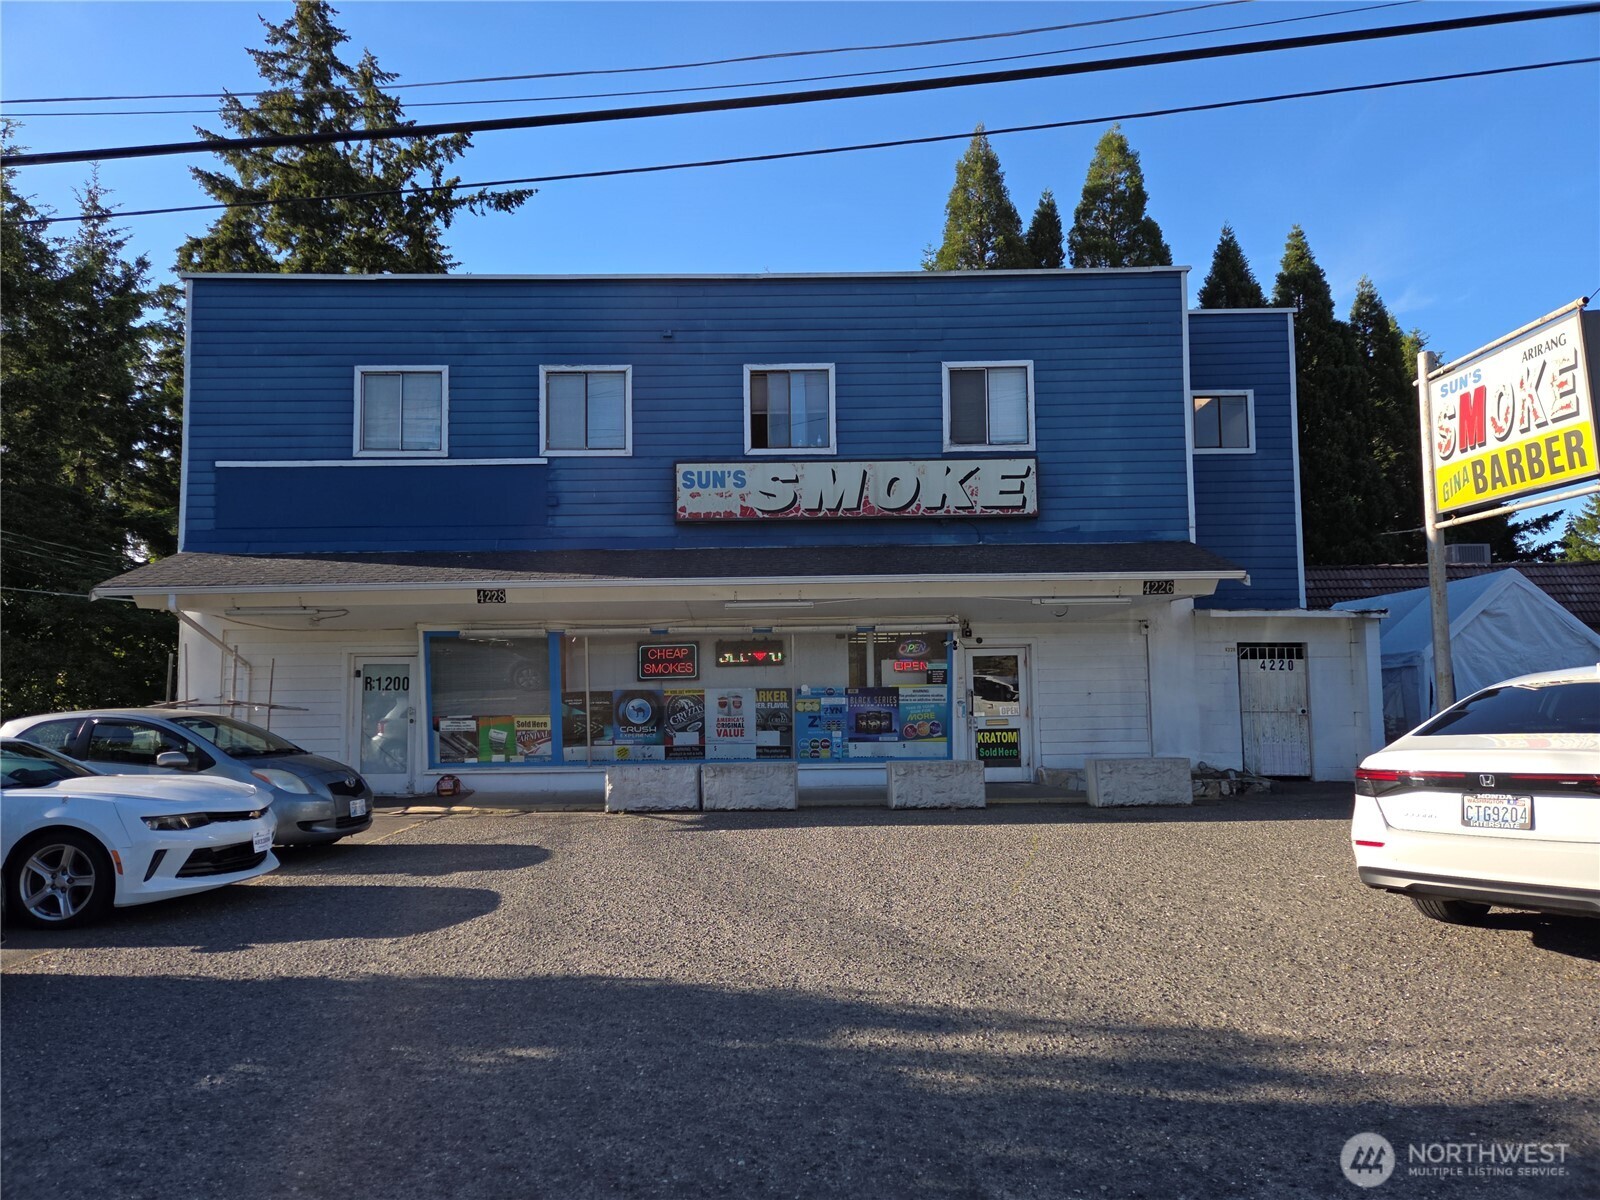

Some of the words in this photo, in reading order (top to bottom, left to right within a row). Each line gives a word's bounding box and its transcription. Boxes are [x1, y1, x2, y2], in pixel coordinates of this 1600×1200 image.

[1521, 332, 1567, 363] ARIRANG
[1440, 368, 1482, 398] SUN'S
[1437, 346, 1580, 461] SMOKE
[1442, 465, 1470, 502] GINA
[1471, 429, 1588, 495] BARBER
[682, 470, 747, 489] SUN'S
[752, 465, 1032, 512] SMOKE
[1143, 581, 1174, 595] 4226
[477, 589, 506, 603] 4228
[648, 648, 688, 660] CHEAP
[899, 643, 926, 654] OPEN
[643, 662, 694, 674] SMOKES
[893, 660, 929, 672] OPEN
[1260, 660, 1294, 671] 4220
[364, 676, 410, 691] R:1.200
[850, 696, 871, 704] BLACK
[874, 695, 897, 704] SERIES
[670, 704, 705, 725] GRIZZLY
[907, 712, 935, 721] MORE
[1001, 706, 1019, 716] OPEN
[516, 720, 531, 729] Sold
[532, 720, 548, 728] Here
[807, 715, 821, 728] Z
[716, 728, 745, 737] VALUE
[977, 731, 1018, 744] KRATOM
[979, 748, 997, 757] Sold
[998, 747, 1018, 757] Here
[1465, 805, 1528, 823] CTG9204
[1470, 821, 1521, 829] INTERSTATE
